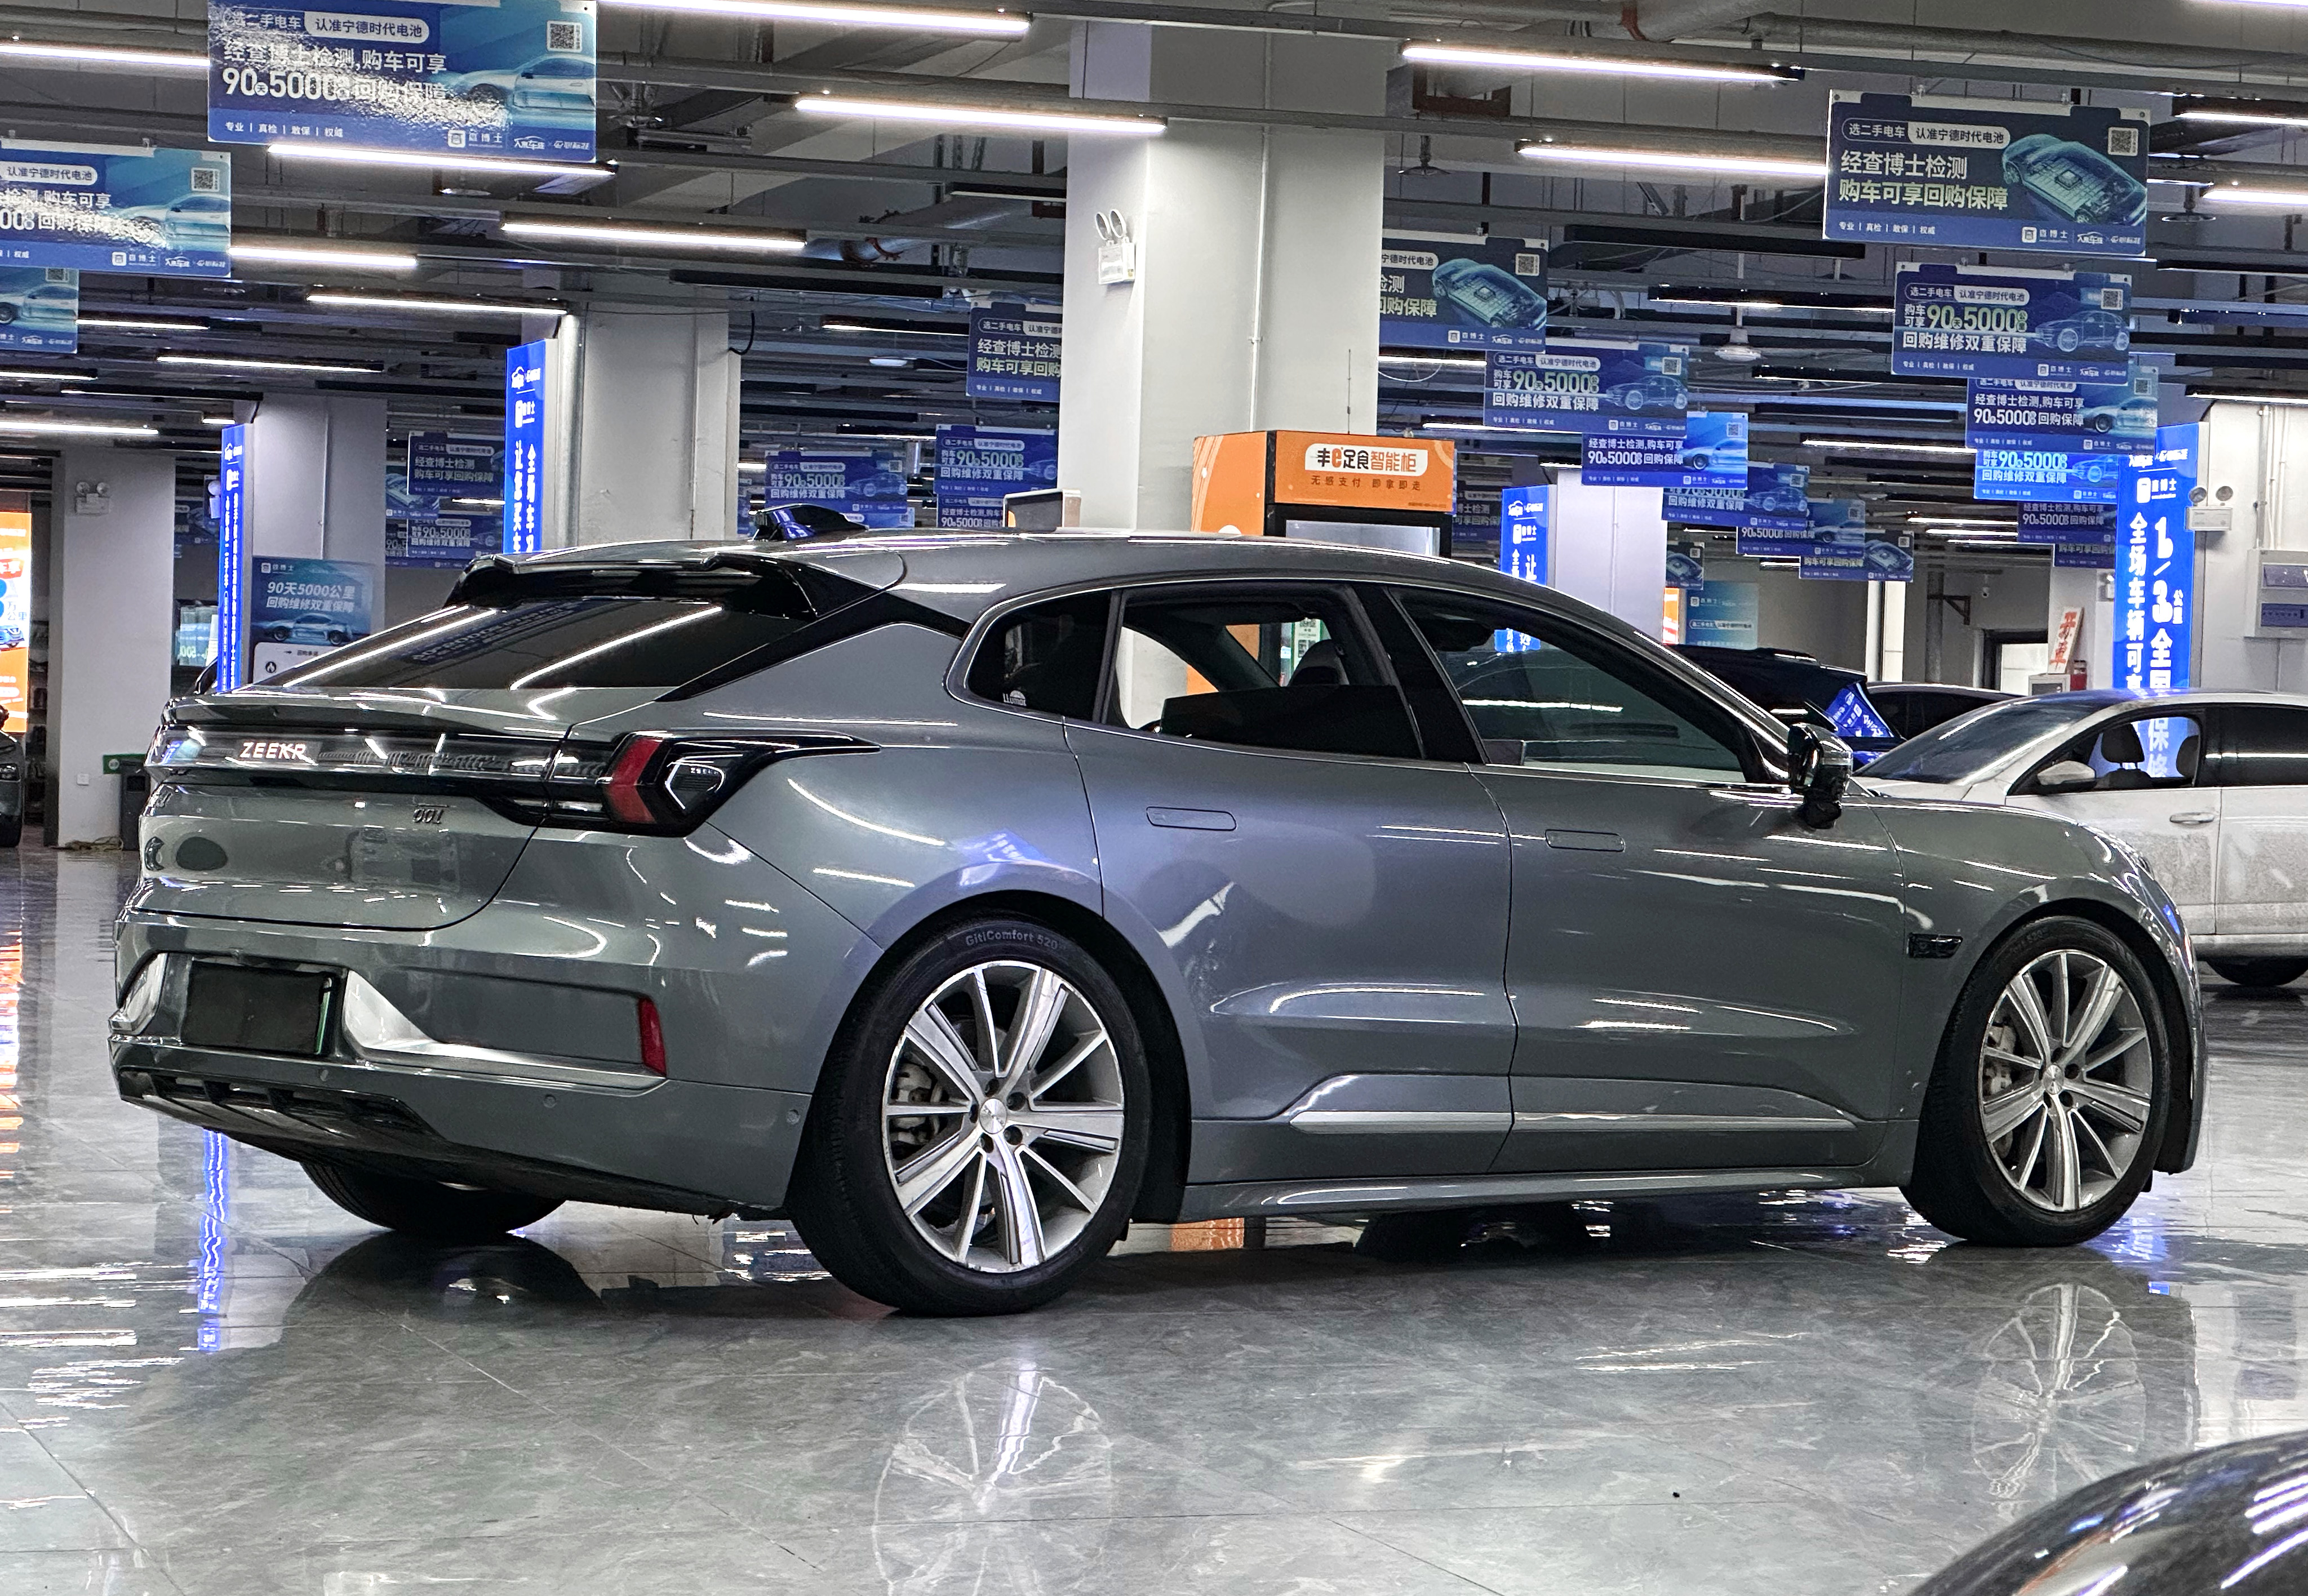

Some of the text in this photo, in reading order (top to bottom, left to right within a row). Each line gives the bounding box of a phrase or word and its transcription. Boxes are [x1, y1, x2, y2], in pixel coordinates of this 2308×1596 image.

[315, 18, 422, 38] 认准宁德时代电池
[225, 122, 244, 132] 专业
[1849, 123, 2004, 144] 选二手电车 认准宁德时代电池
[8, 166, 92, 181] 认准宁德时代电池
[1841, 150, 1967, 180] 经查博士检测
[1839, 179, 2008, 210] 购车可享回购保障
[1839, 222, 1854, 231] 专业
[1382, 254, 1433, 266] 宁德时代电池
[1910, 286, 2025, 303] 选二手电车 认准宁德时代电池
[978, 339, 1062, 359] 经查博士检测
[1902, 332, 2027, 354] 回购维修双重保障
[976, 357, 1061, 378] 购车可享回购
[1493, 392, 1599, 411] 回购维修双重保障
[415, 457, 475, 470] 经查博士检测
[1311, 475, 1421, 491] 无感支付 即拿即走
[1982, 470, 2067, 484] 回购维修双重保障
[942, 508, 1003, 517] 经查博士检测,购车
[267, 581, 356, 599] 90天5000公里
[266, 596, 354, 613] 回购维修双重保障
[240, 742, 307, 759] ZEEKR
[1037, 934, 1059, 949] 520
